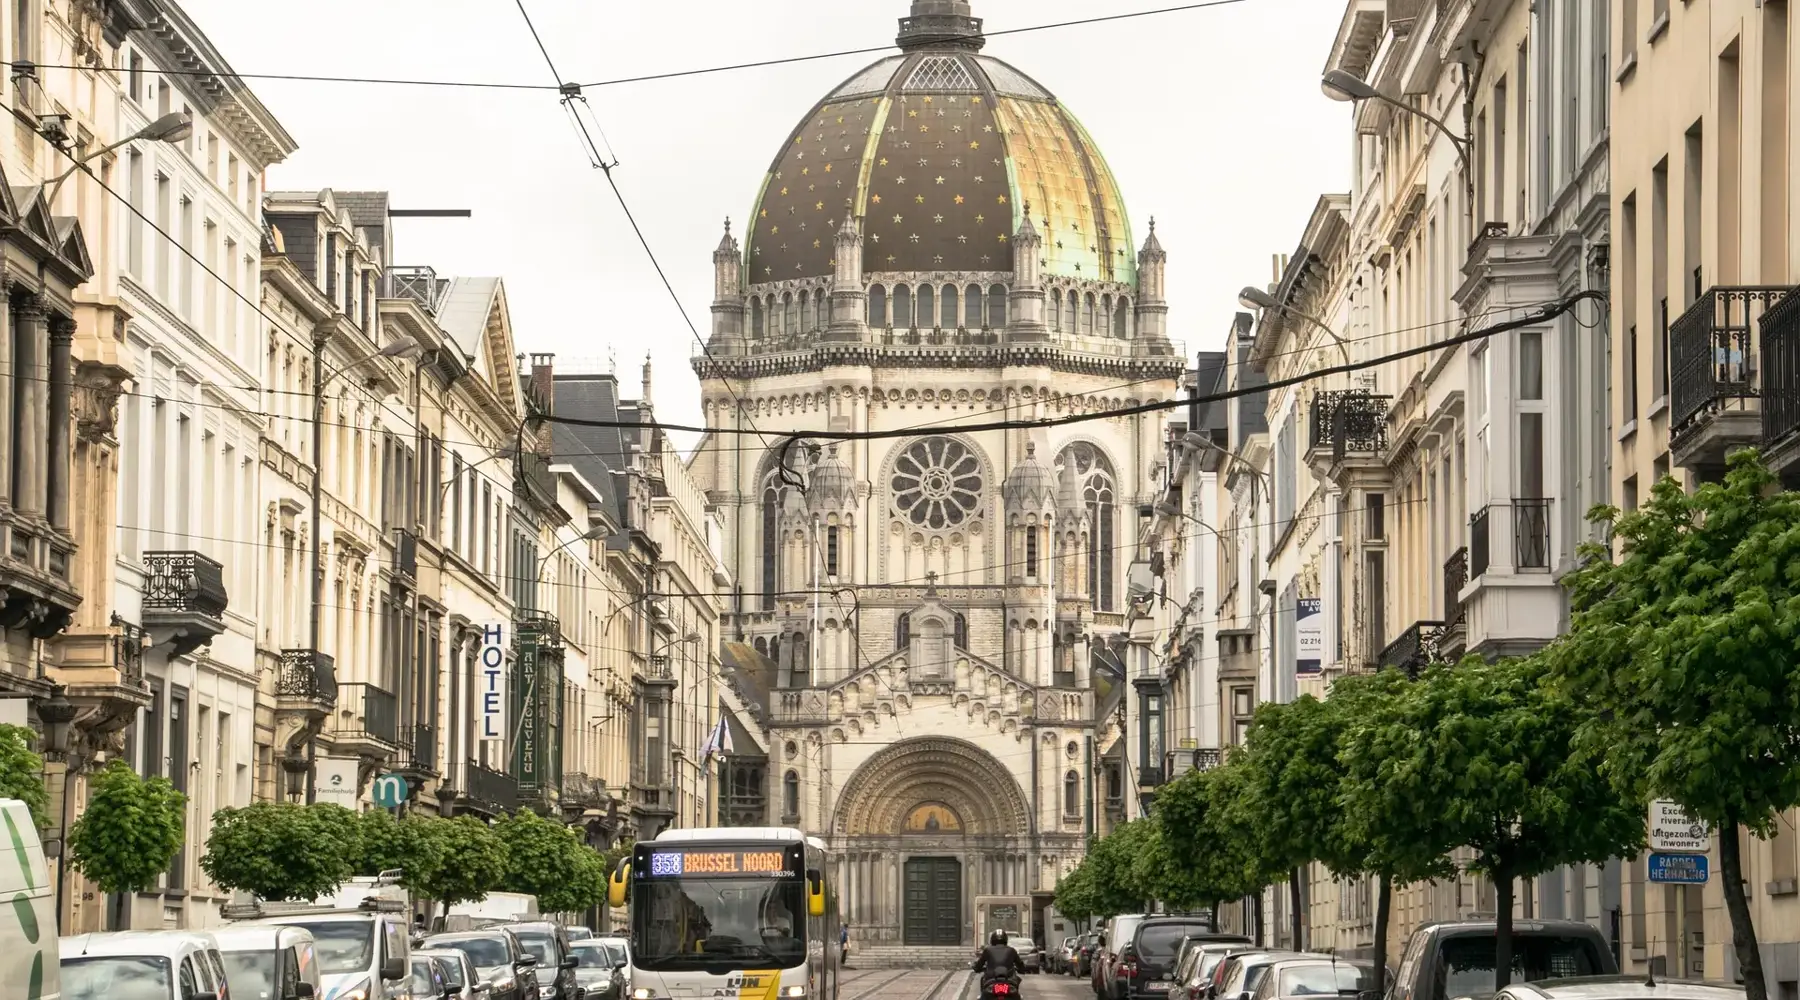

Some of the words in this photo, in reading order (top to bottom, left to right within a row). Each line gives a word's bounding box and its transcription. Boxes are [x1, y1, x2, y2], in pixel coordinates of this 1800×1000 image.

[483, 624, 502, 736] HOTEL
[524, 652, 534, 684] ART
[653, 854, 681, 873] 358
[684, 852, 739, 873] BRUSSEL
[743, 852, 783, 872] NOORD
